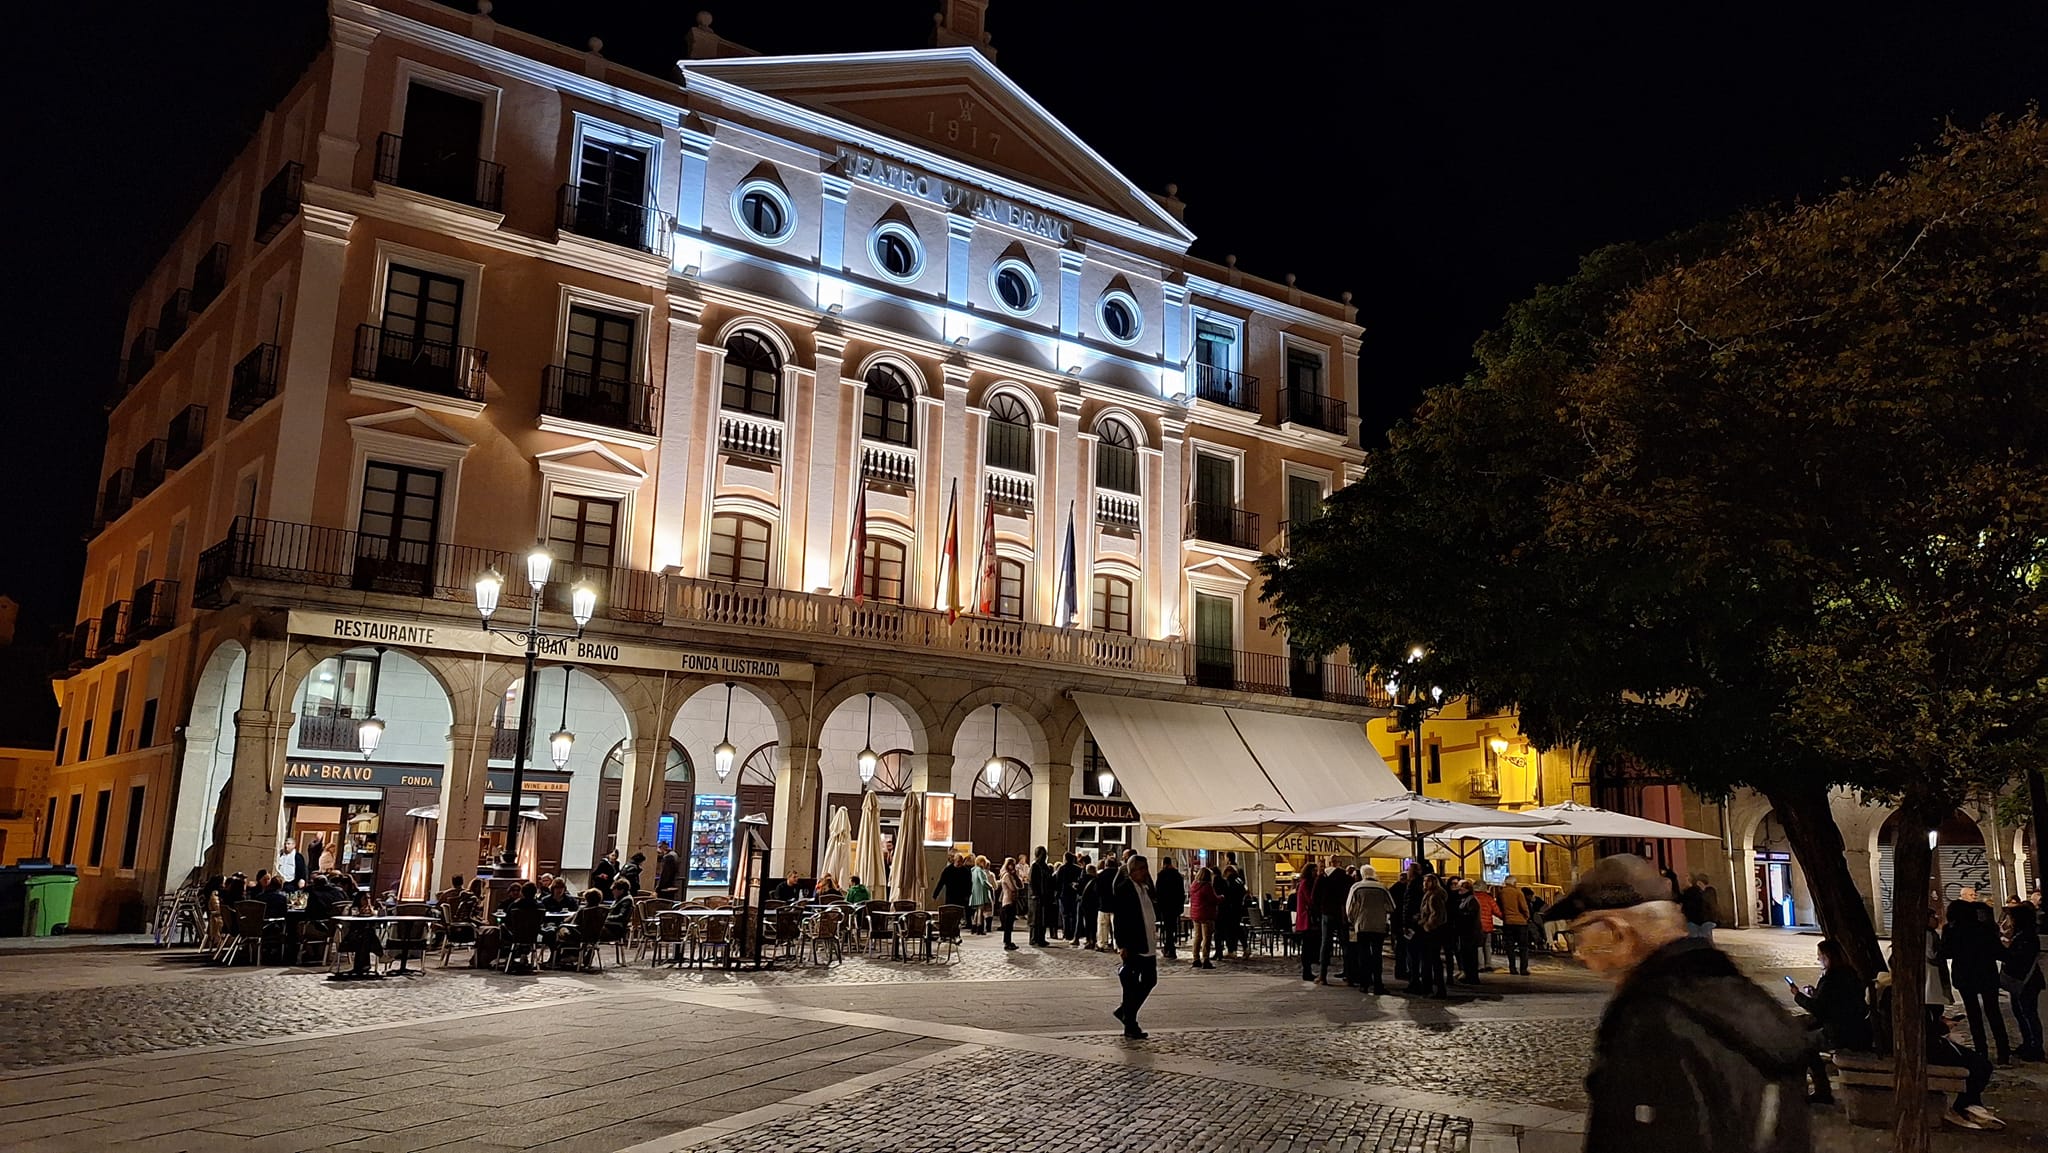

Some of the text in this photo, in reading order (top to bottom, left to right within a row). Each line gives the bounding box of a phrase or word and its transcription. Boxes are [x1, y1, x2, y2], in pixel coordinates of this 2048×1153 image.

[926, 111, 1001, 156] 1917
[841, 151, 1072, 242] TEATRO JUAN BRAVO
[334, 618, 435, 645] RESTAURANTE
[577, 642, 619, 661] BRAVO
[681, 654, 781, 677] FONDA ILUSTRADA
[321, 765, 373, 781] BRAVO
[401, 775, 434, 787] FONDA
[1073, 803, 1134, 819] TAQUILLA
[1276, 835, 1340, 853] CAFÉ JEYMA
